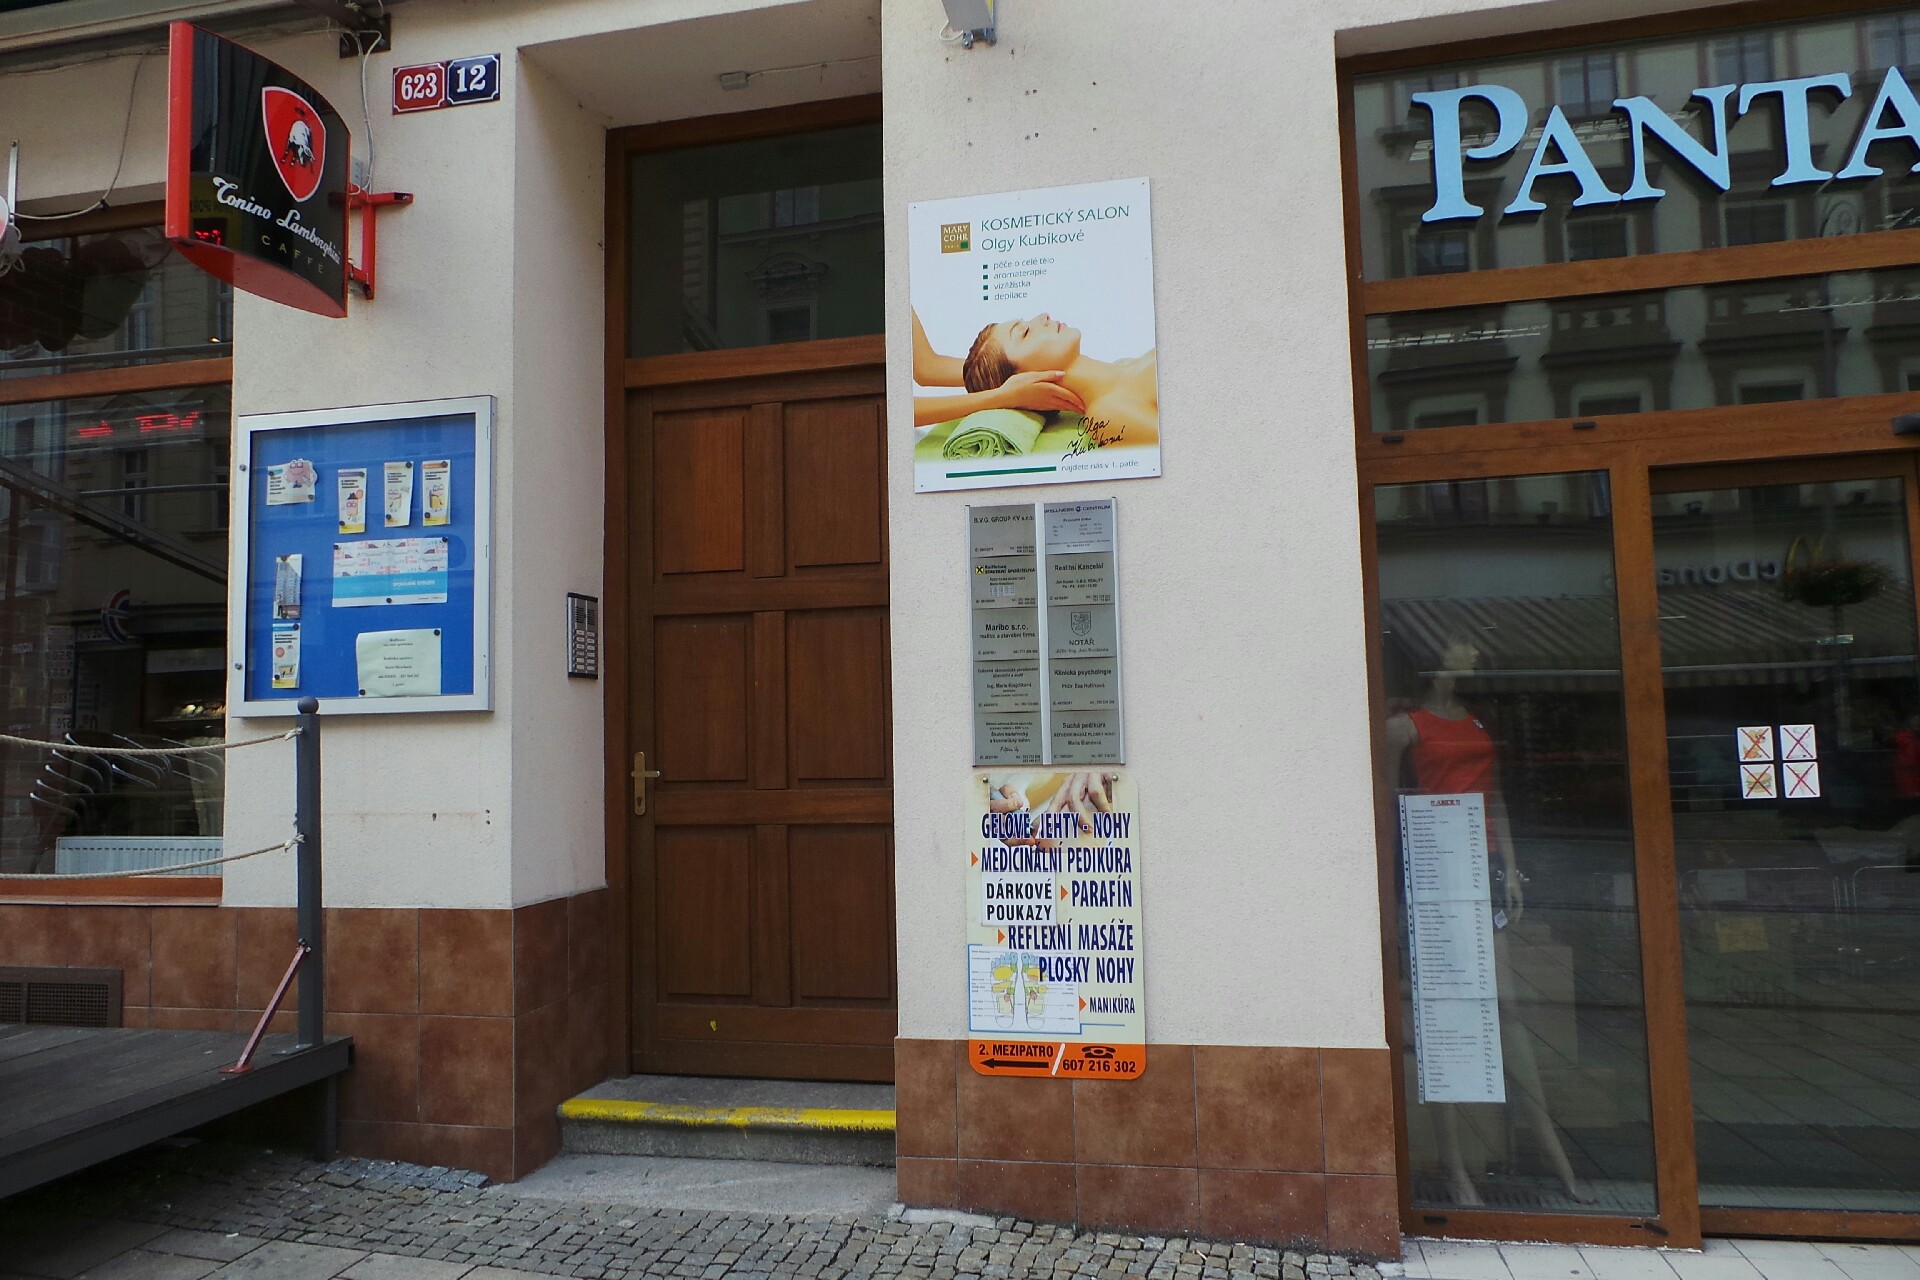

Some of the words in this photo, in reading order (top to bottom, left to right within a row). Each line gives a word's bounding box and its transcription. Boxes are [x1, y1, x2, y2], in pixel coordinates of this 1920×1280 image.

[401, 72, 437, 100] 623
[456, 64, 486, 93] 12
[1411, 66, 1920, 224] PANTA
[212, 176, 272, 219] Tonino
[276, 209, 341, 265] Lamborghini
[981, 209, 1074, 232] KOSMETICKÝ
[1077, 204, 1130, 222] SALON
[943, 224, 968, 234] MARY
[943, 233, 968, 242] COHR
[261, 234, 324, 274] CAFFE
[981, 238, 1015, 253] Olgy
[993, 260, 1013, 271] péče
[1021, 258, 1038, 267] celé
[993, 268, 1047, 280] aromaterapie
[993, 280, 1031, 291] vizážistka
[994, 291, 1028, 302] depilace
[1077, 416, 1110, 440] Olga
[1061, 464, 1089, 473] najdete
[1119, 460, 1139, 469] patře
[991, 515, 1011, 523] GROUP
[985, 623, 1010, 631] Maribo
[1069, 637, 1095, 646] NOTÁŘ
[1077, 669, 1112, 677] psychologie
[981, 808, 1031, 839] GELOVÉ
[1093, 812, 1131, 839] NOHY
[981, 842, 1063, 873] MEDICINÁLNÍ
[1067, 842, 1132, 873] PEDIKÚRA
[986, 878, 1052, 900] DÁRKOVÉ
[1071, 874, 1132, 908] PARAFÍN
[987, 904, 1053, 921] POUKAZY
[1008, 918, 1073, 950] REFLEXNÍ
[1078, 918, 1134, 951] MASÁŽE
[1039, 956, 1090, 983] PLOSKY
[1096, 957, 1135, 983] NOHY
[1089, 994, 1136, 1014] MANIKÚRA
[979, 1044, 989, 1056] 2.
[992, 1044, 1054, 1058] MEZIPATRO
[1062, 1059, 1085, 1071] 607
[1088, 1060, 1110, 1072] 216
[1114, 1060, 1136, 1073] 302
